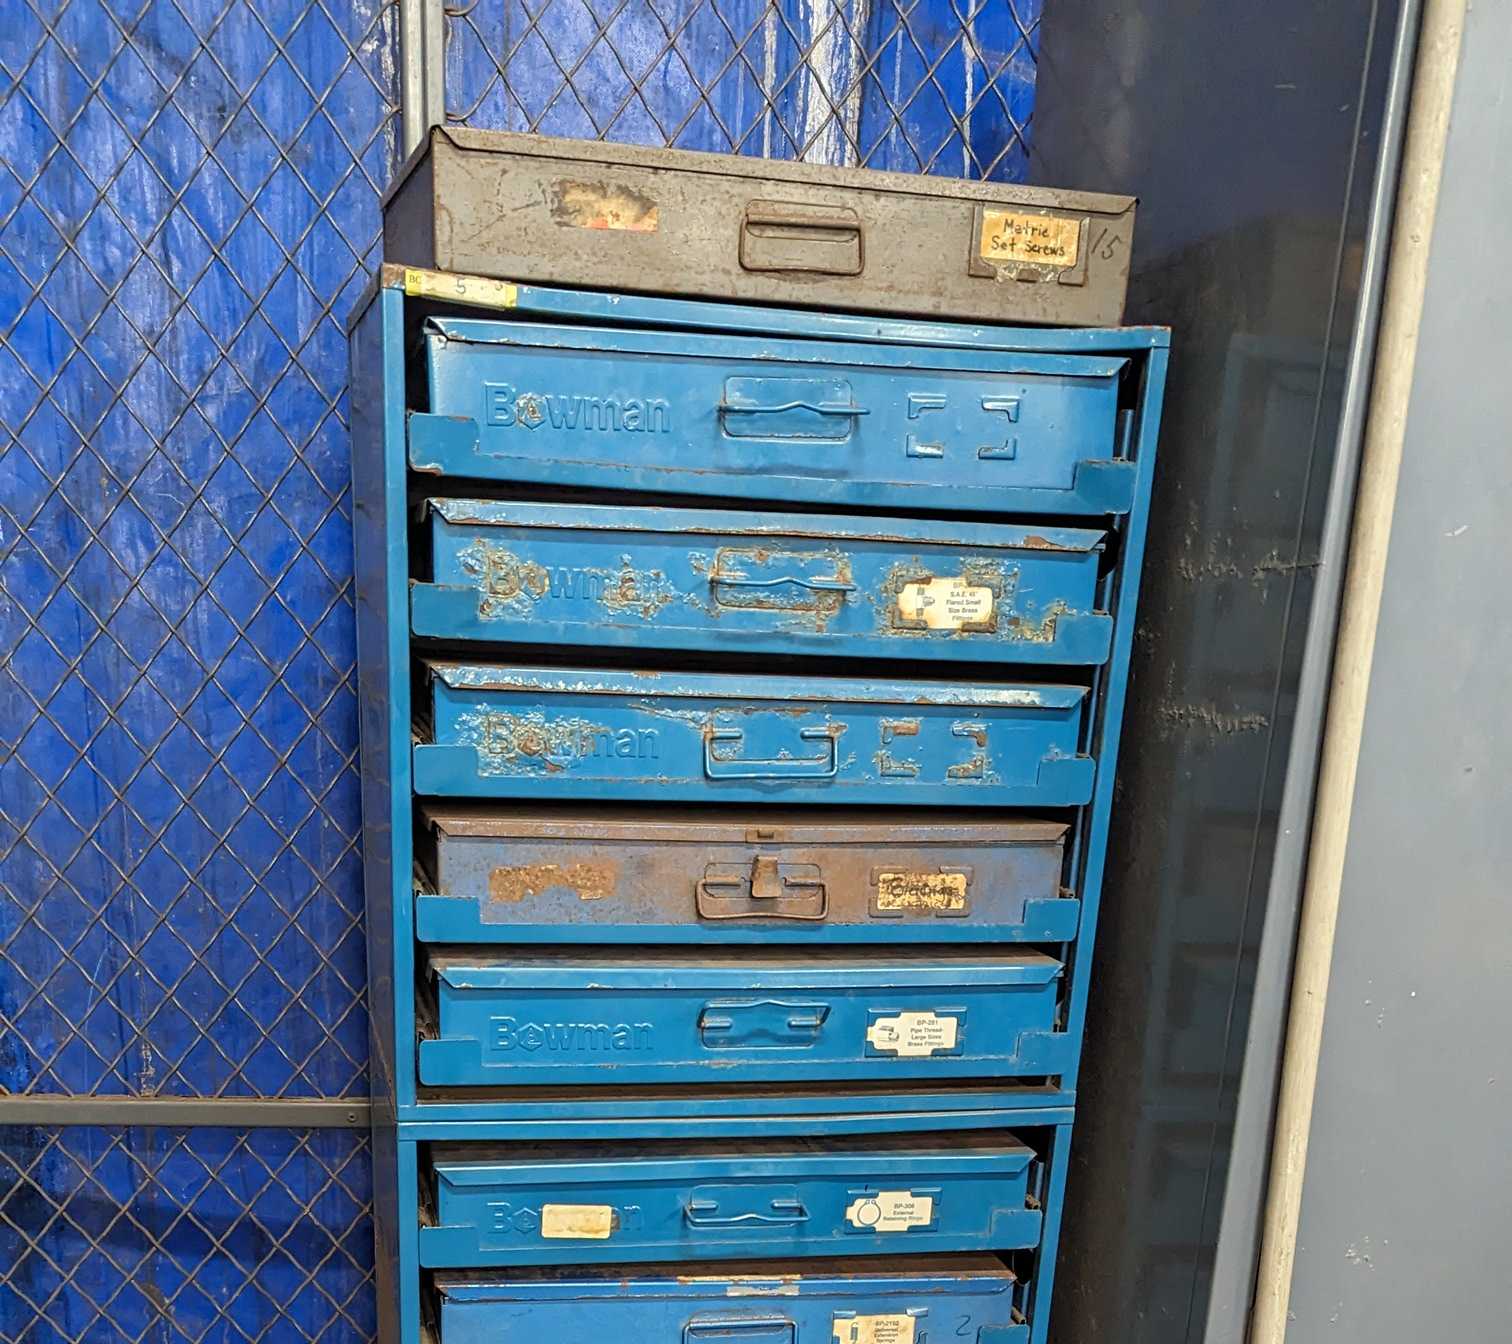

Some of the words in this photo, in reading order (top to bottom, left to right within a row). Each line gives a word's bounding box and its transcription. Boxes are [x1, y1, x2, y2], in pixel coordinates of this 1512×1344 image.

[1003, 218, 1050, 237] Metric
[991, 235, 1017, 253] Set
[1091, 227, 1123, 260] 15
[456, 279, 466, 295] 5
[484, 381, 669, 432] Bowman
[487, 1015, 655, 1051] Bowman
